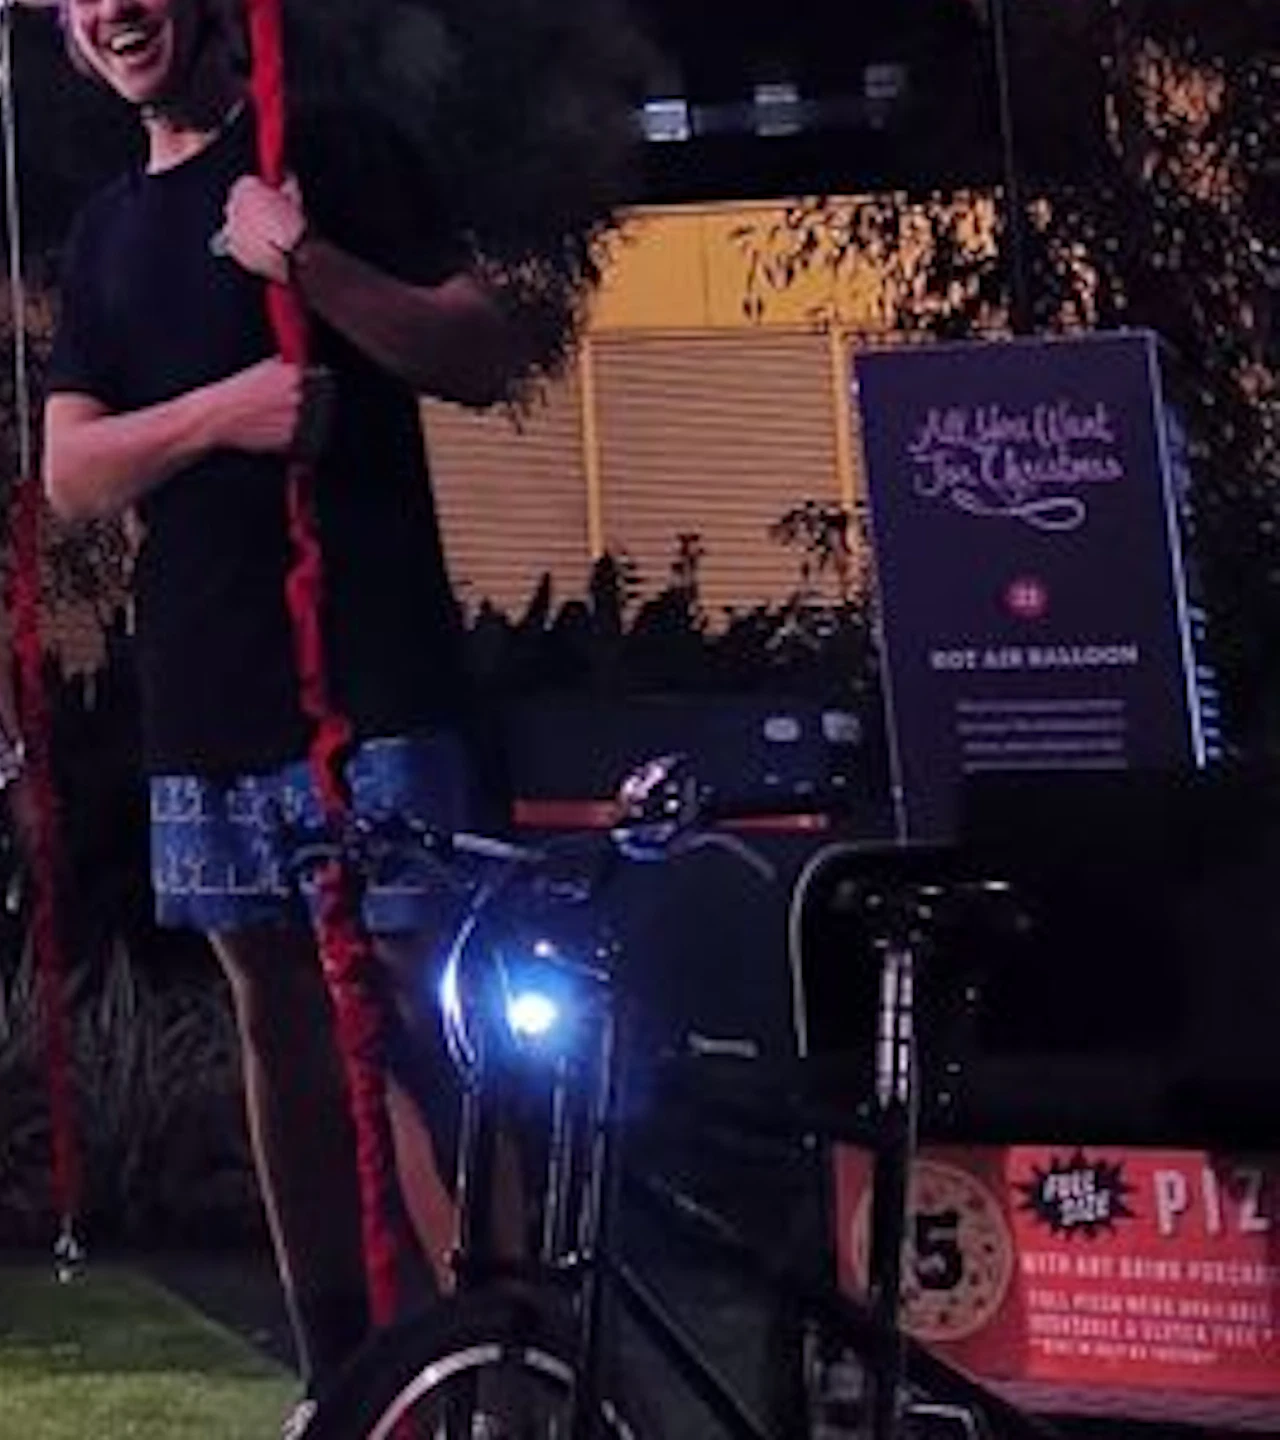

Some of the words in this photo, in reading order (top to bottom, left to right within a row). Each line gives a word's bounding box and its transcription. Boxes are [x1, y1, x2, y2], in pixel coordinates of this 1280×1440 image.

[1033, 399, 1115, 447] Want
[978, 443, 1125, 500] Christmas
[981, 647, 1024, 670] AIR
[1026, 643, 1139, 668] BALLOON
